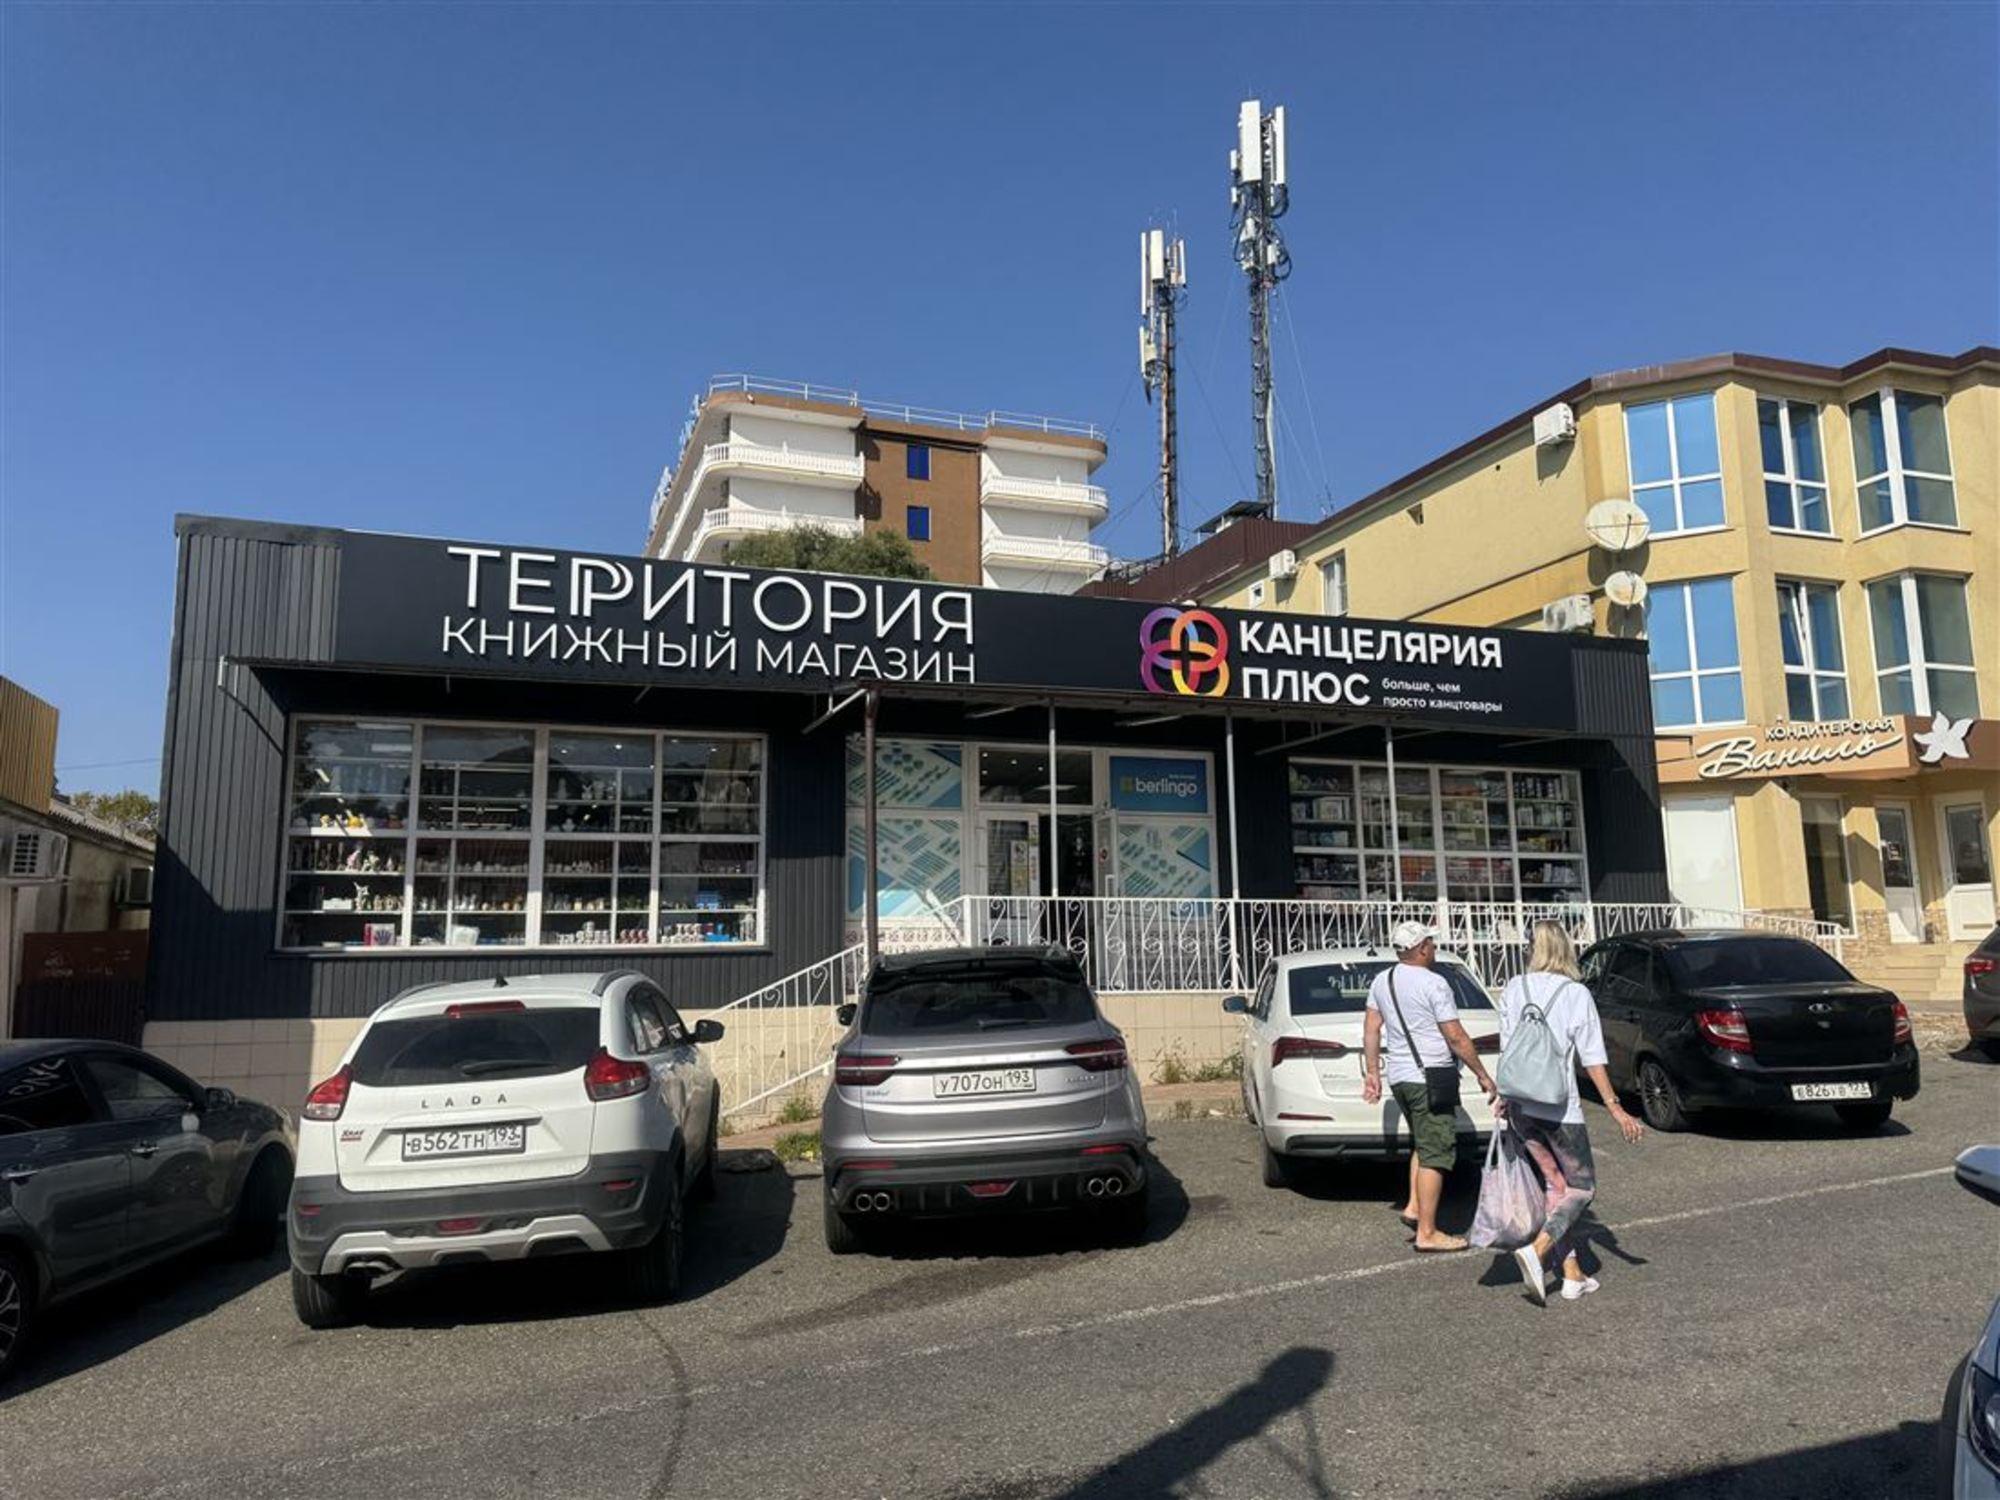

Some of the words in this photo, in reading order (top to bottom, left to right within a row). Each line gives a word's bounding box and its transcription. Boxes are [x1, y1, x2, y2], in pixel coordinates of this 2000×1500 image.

[442, 615, 738, 671] КНИЖНЫЙ
[756, 638, 976, 684] МАГАЗИН
[1239, 620, 1503, 668] КАНЦЕЛЯРИЯ
[1242, 667, 1371, 706] ПЛЮС
[1381, 678, 1434, 693] больше,
[1436, 683, 1461, 693] чем
[1383, 697, 1427, 708] просто
[1429, 699, 1503, 713] канцтовары
[1765, 717, 1896, 742] КОНДИТЕРСКАЯ
[1696, 730, 1904, 778] Ваниль
[1136, 777, 1198, 798] berlingo
[421, 1093, 508, 1109] LADA
